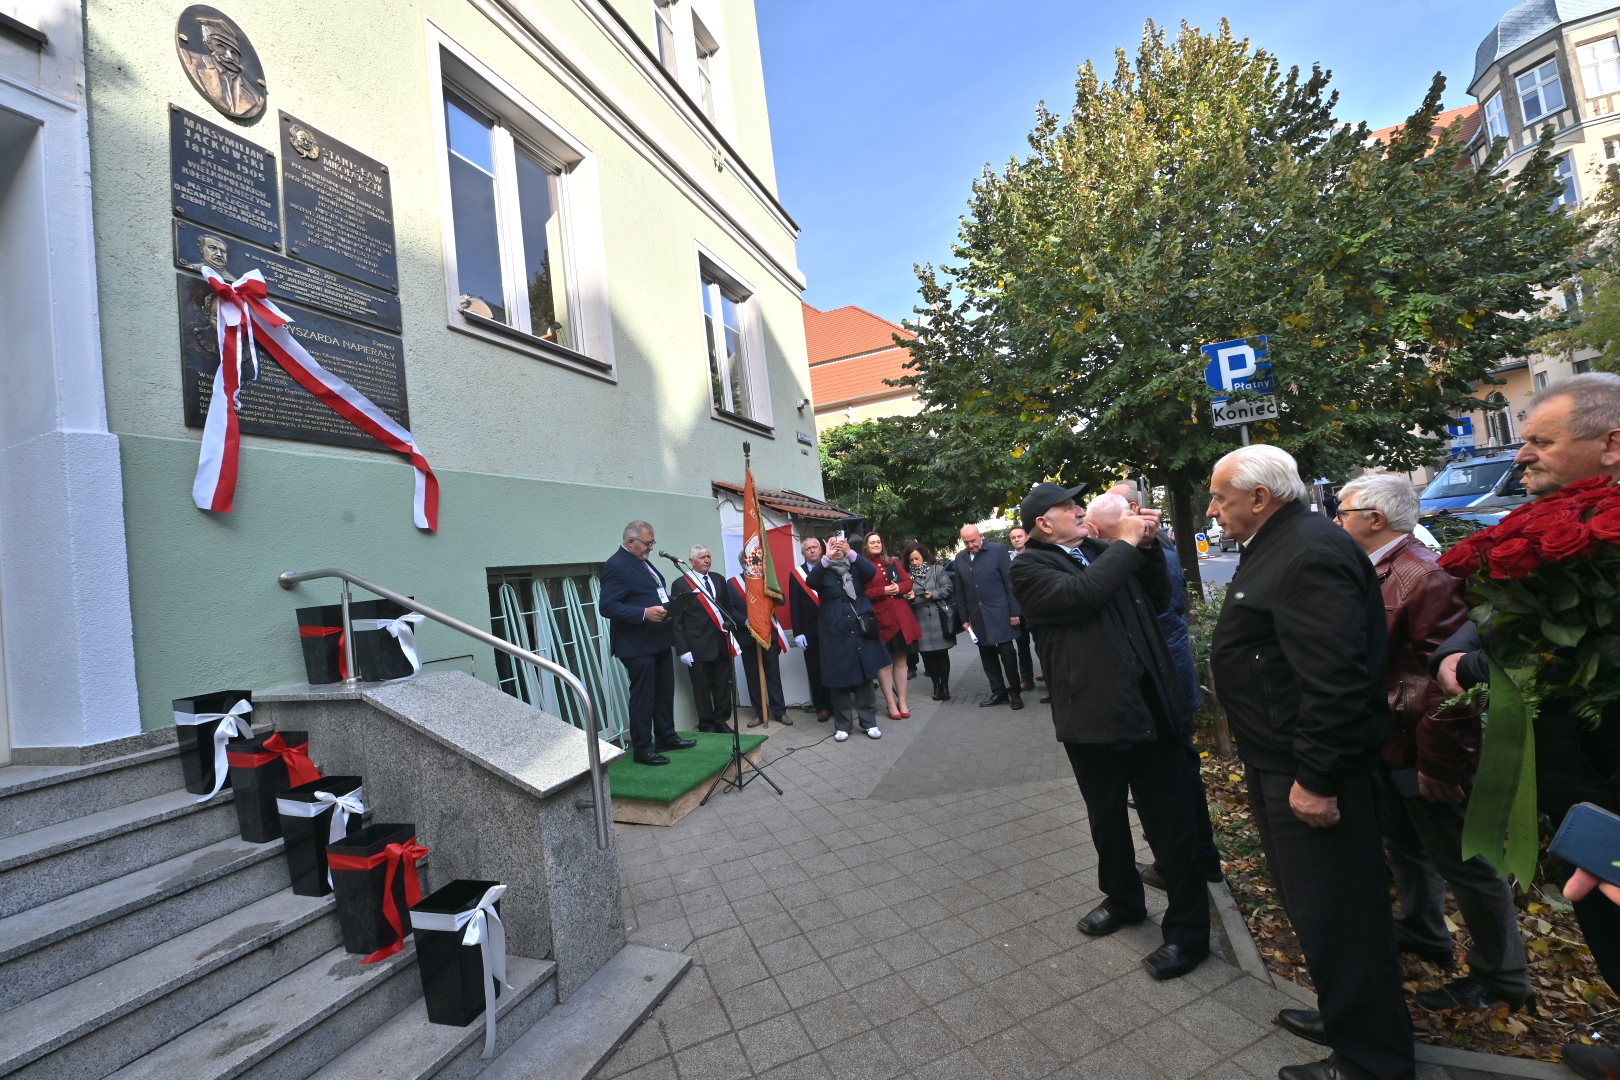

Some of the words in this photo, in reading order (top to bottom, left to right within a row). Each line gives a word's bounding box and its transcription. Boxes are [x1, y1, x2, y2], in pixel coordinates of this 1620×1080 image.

[184, 116, 263, 162] MAKSYMILIAN
[184, 127, 264, 171] JACKOWSKI
[184, 140, 214, 158] 1815
[236, 163, 265, 181] 1905
[201, 159, 253, 186] PATRONOWI
[322, 148, 382, 184] STANISŁAW
[323, 157, 383, 192] MIKOŁAJCZYK
[188, 161, 265, 198] WIELKOPOLSKICH
[218, 182, 270, 207] ROLNICZYCH
[206, 190, 220, 198] 120
[226, 198, 249, 210] LECIE
[287, 276, 322, 292] JULIUSZOWI
[323, 273, 336, 281] 2012
[282, 323, 339, 346] RYSZARDA
[342, 340, 395, 360] NAPIERAŁY
[1218, 345, 1256, 392] P
[1234, 380, 1270, 390] Płatny
[1214, 402, 1276, 422] Koniec
